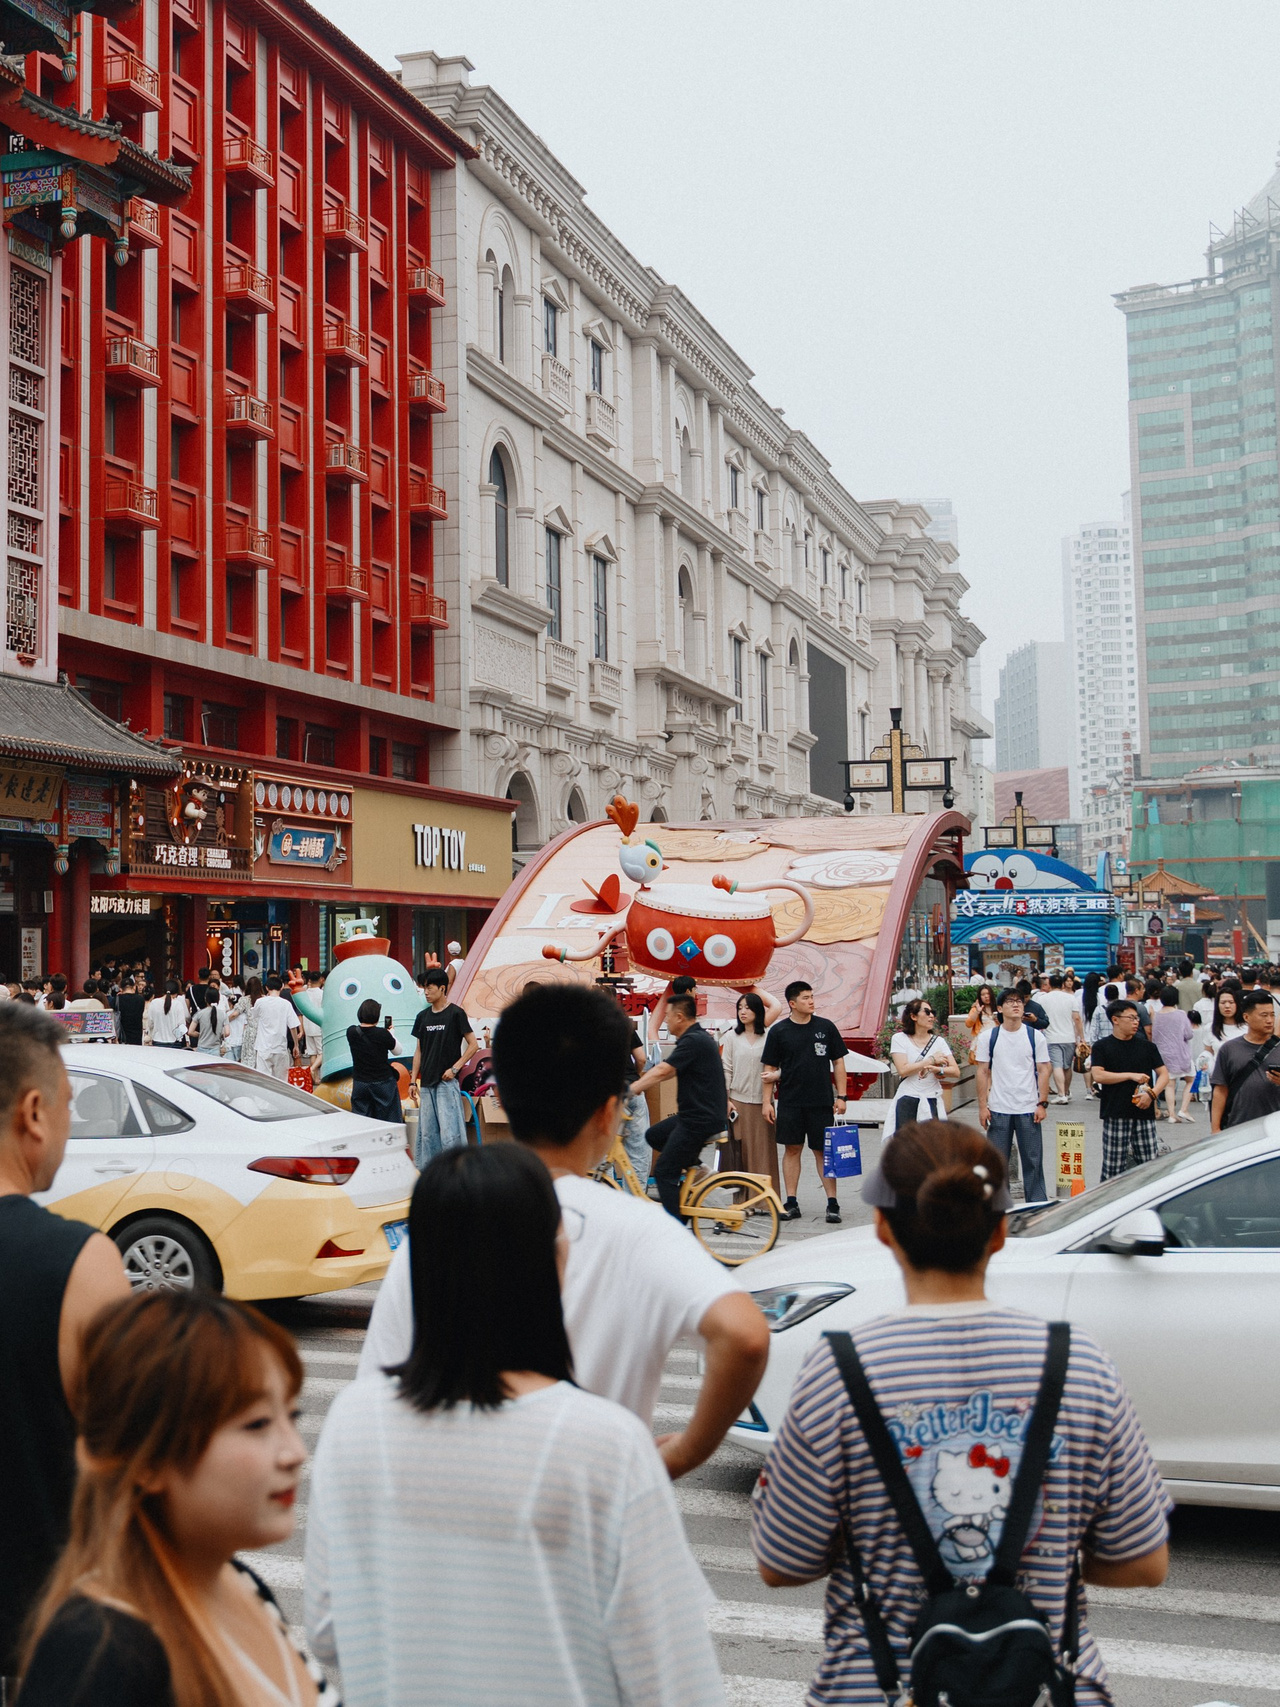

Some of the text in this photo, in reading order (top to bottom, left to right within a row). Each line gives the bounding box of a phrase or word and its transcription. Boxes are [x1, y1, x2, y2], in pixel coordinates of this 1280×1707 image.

[154, 844, 199, 867] 巧克查理
[413, 823, 466, 871] TOP TOY
[90, 896, 151, 915] 沈阳巧克力乐园
[1060, 1151, 1082, 1163] 专用
[1060, 1163, 1083, 1175] 通道
